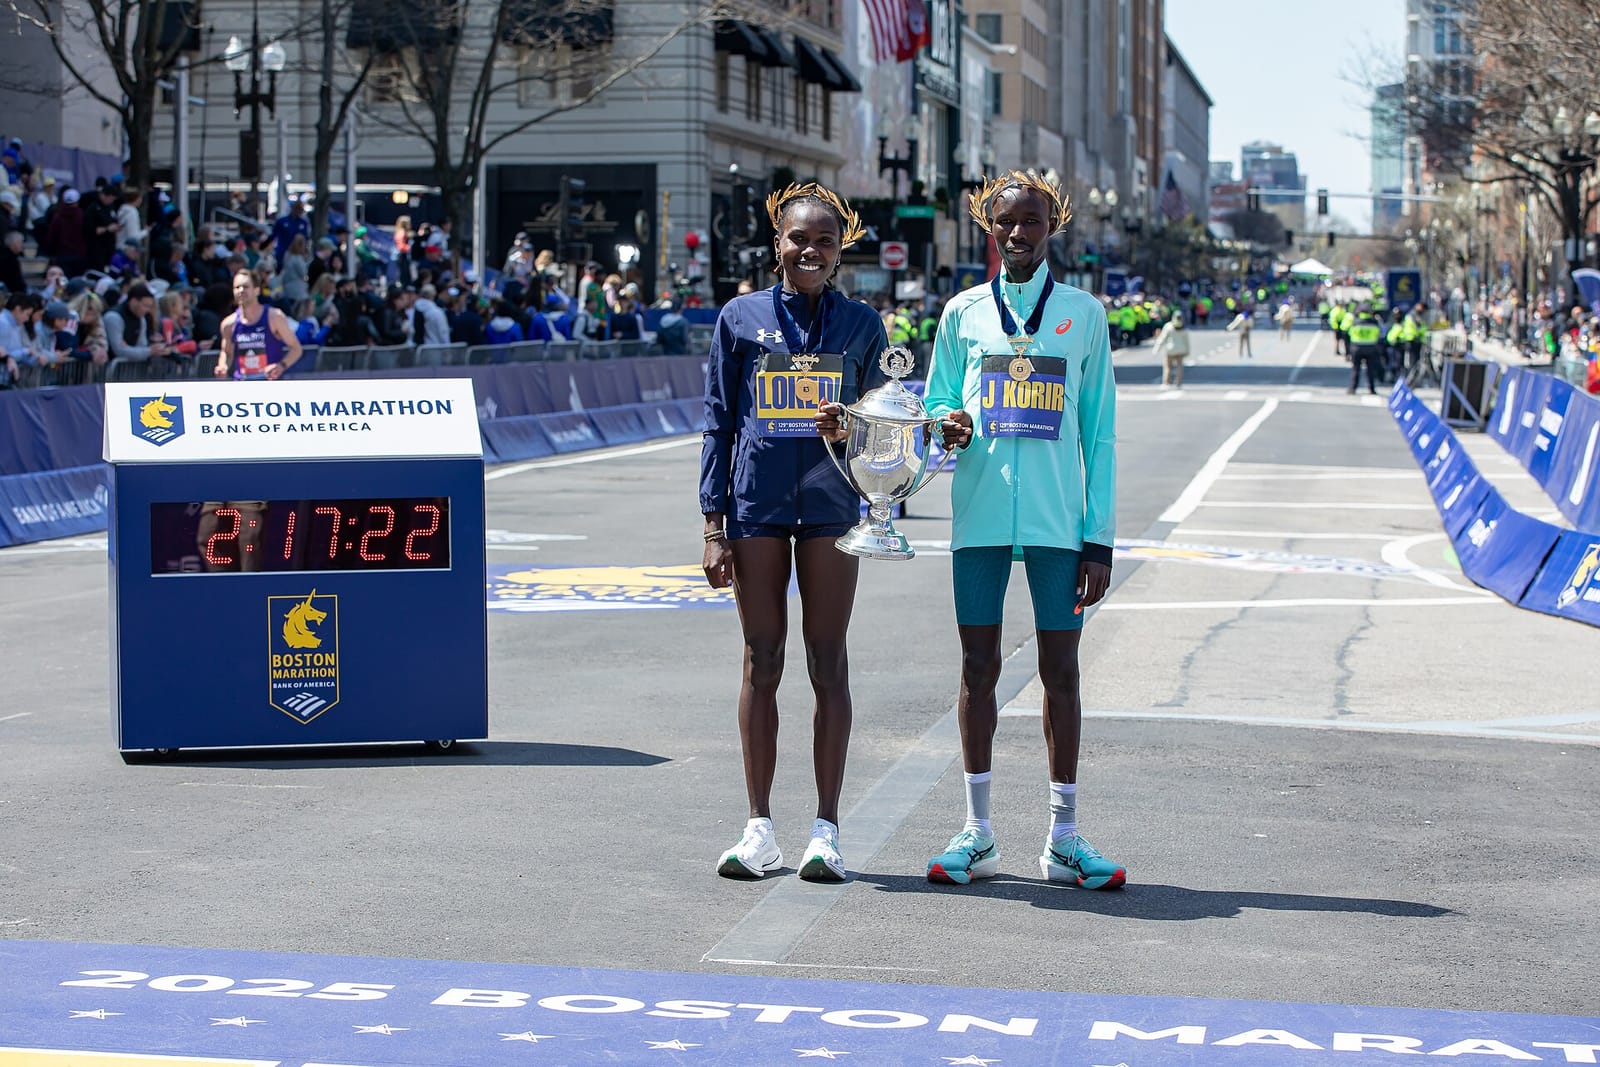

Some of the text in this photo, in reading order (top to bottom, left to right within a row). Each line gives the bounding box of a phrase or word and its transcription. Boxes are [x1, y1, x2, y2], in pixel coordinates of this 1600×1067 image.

[982, 380, 1064, 412] J KORIR
[200, 400, 452, 418] BOSTON MARATHON
[201, 422, 372, 434] BANK OF AMERICA
[1029, 423, 1055, 431] MARATHON
[206, 505, 440, 564] 2:17:22
[272, 653, 335, 668] BOSTON
[272, 667, 336, 679] MARATHON
[59, 968, 1600, 1064] 2025 BOSTON MARAT
